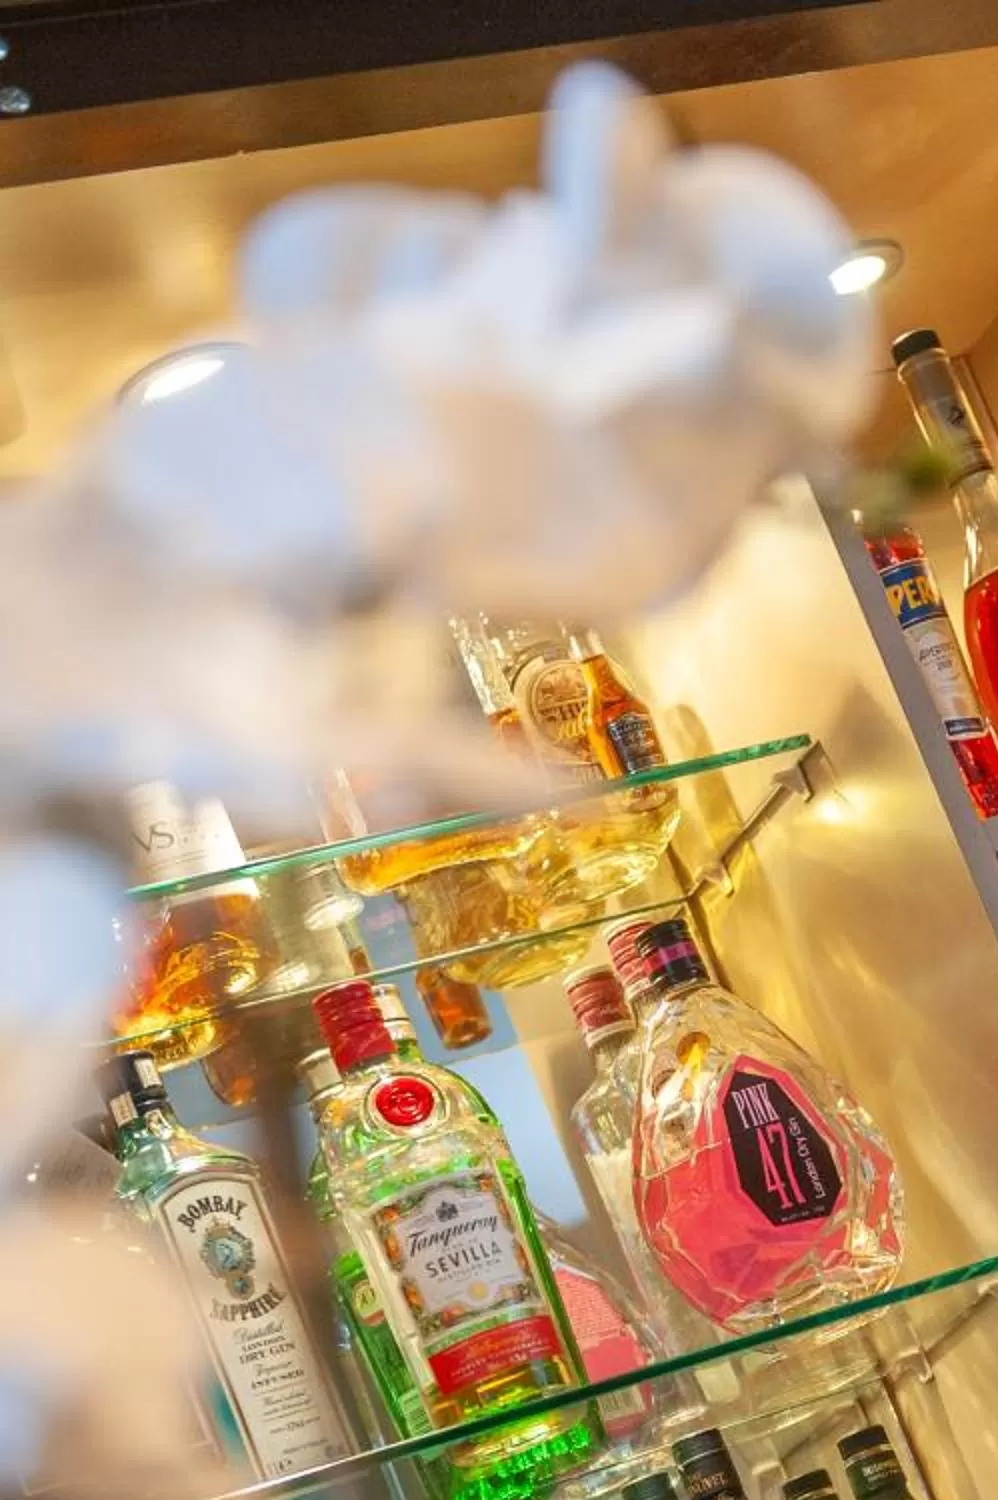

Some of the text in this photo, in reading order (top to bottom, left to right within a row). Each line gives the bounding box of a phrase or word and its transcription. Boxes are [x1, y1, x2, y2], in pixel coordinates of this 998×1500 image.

[731, 1082, 780, 1130] PINK
[756, 1122, 807, 1209] 47
[177, 1195, 248, 1232] BOMBAY
[408, 1214, 499, 1259] Tanqueray
[425, 1241, 503, 1279] SEVILLA
[209, 1283, 287, 1322] SAPPHIRE
